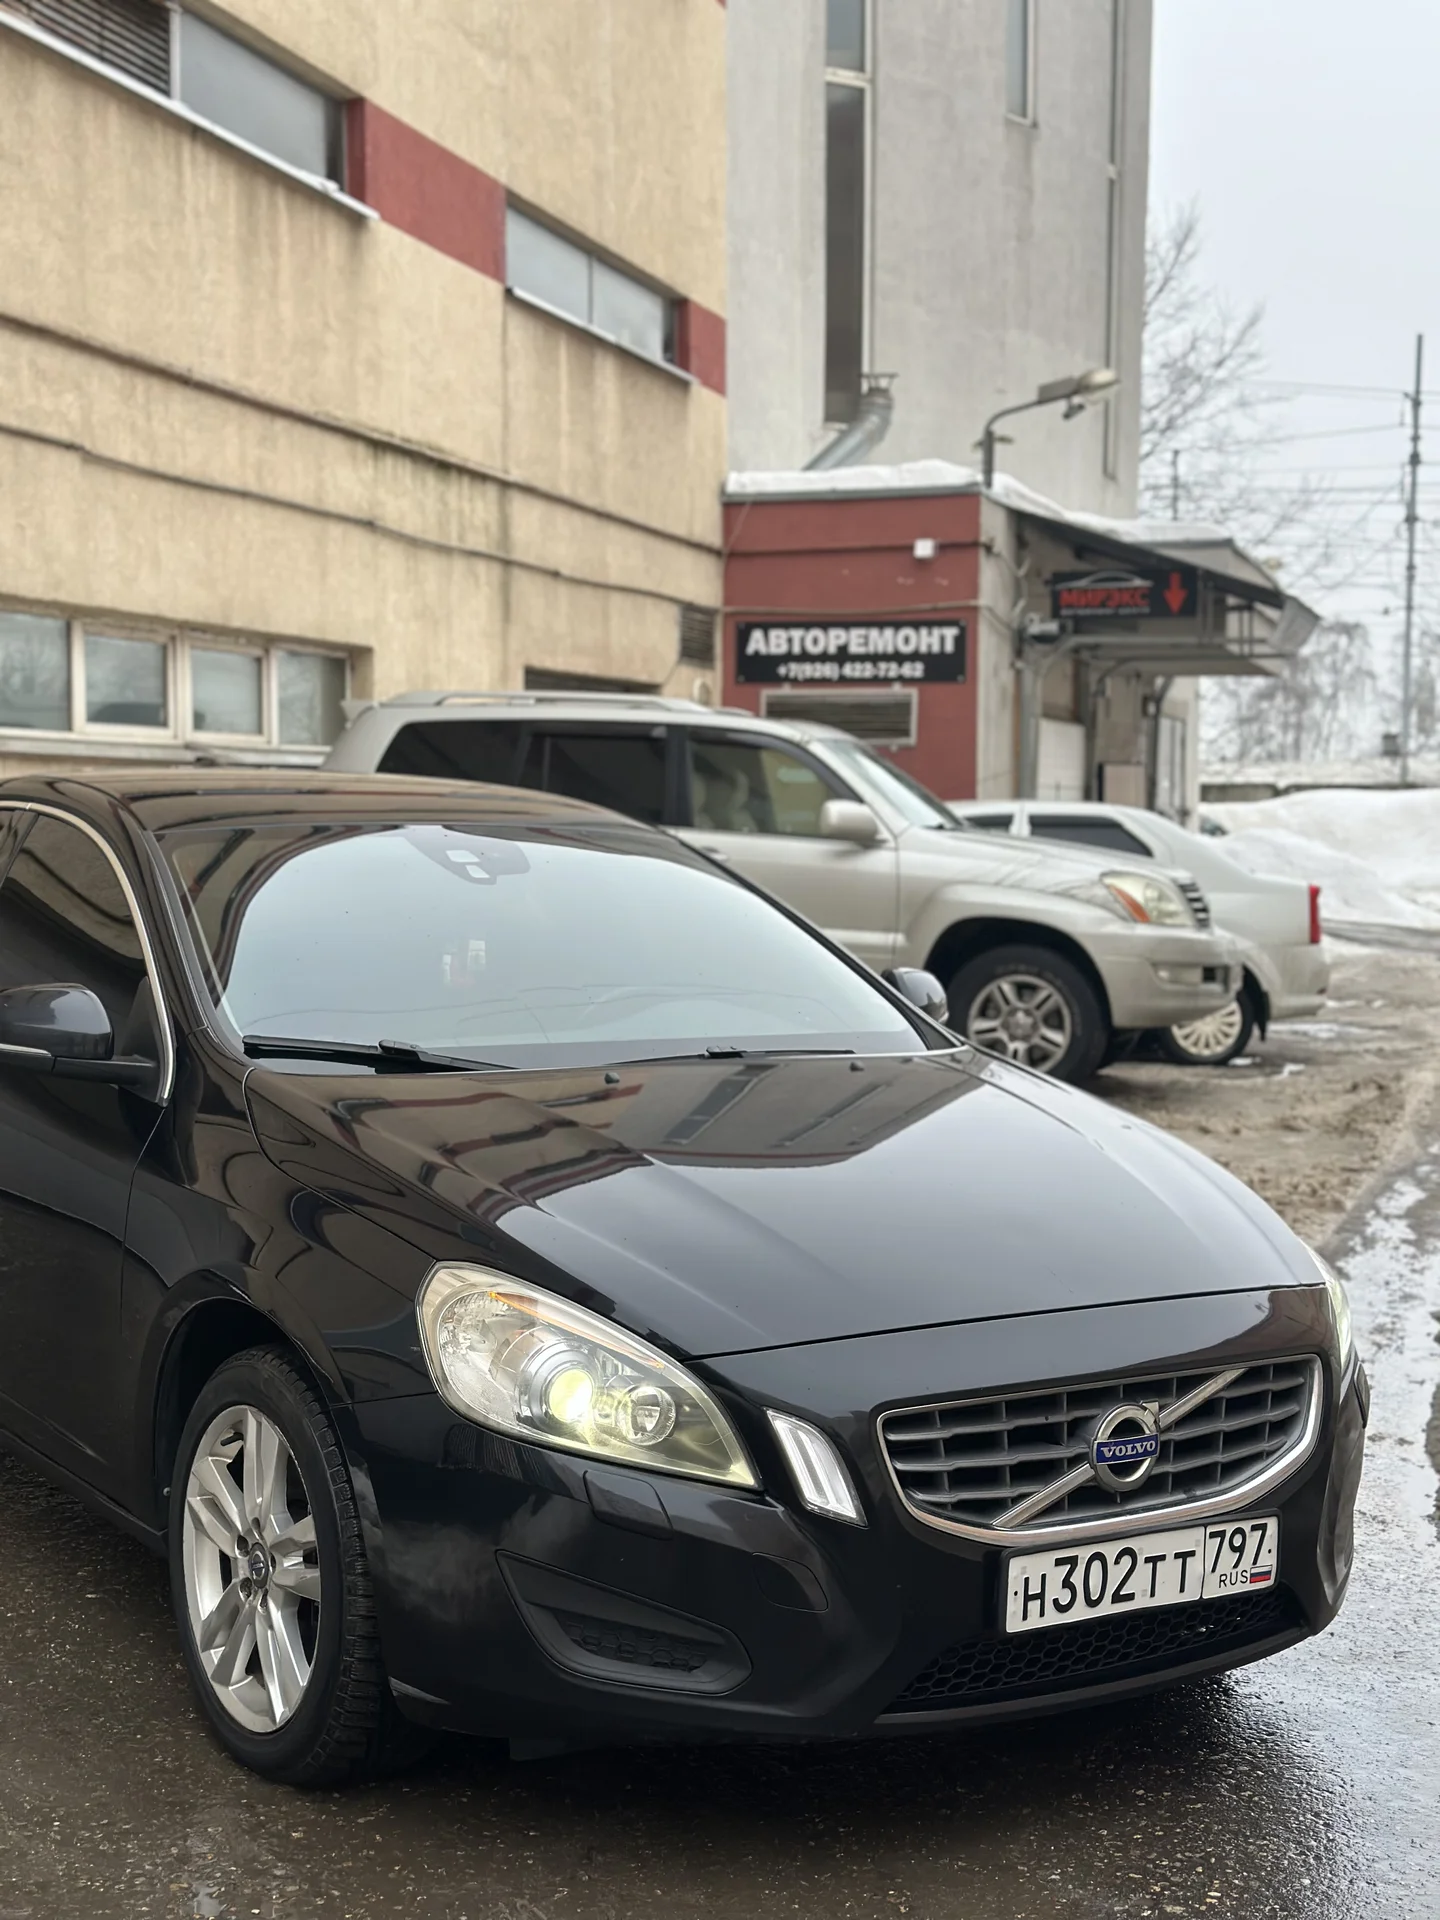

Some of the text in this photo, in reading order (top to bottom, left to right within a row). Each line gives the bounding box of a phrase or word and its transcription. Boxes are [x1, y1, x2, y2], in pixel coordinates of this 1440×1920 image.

[745, 626, 960, 656] АВТОРЕМОНТ
[1100, 1440, 1156, 1458] VOLVO
[1208, 1522, 1268, 1574] 797
[1218, 1569, 1249, 1589] RUS
